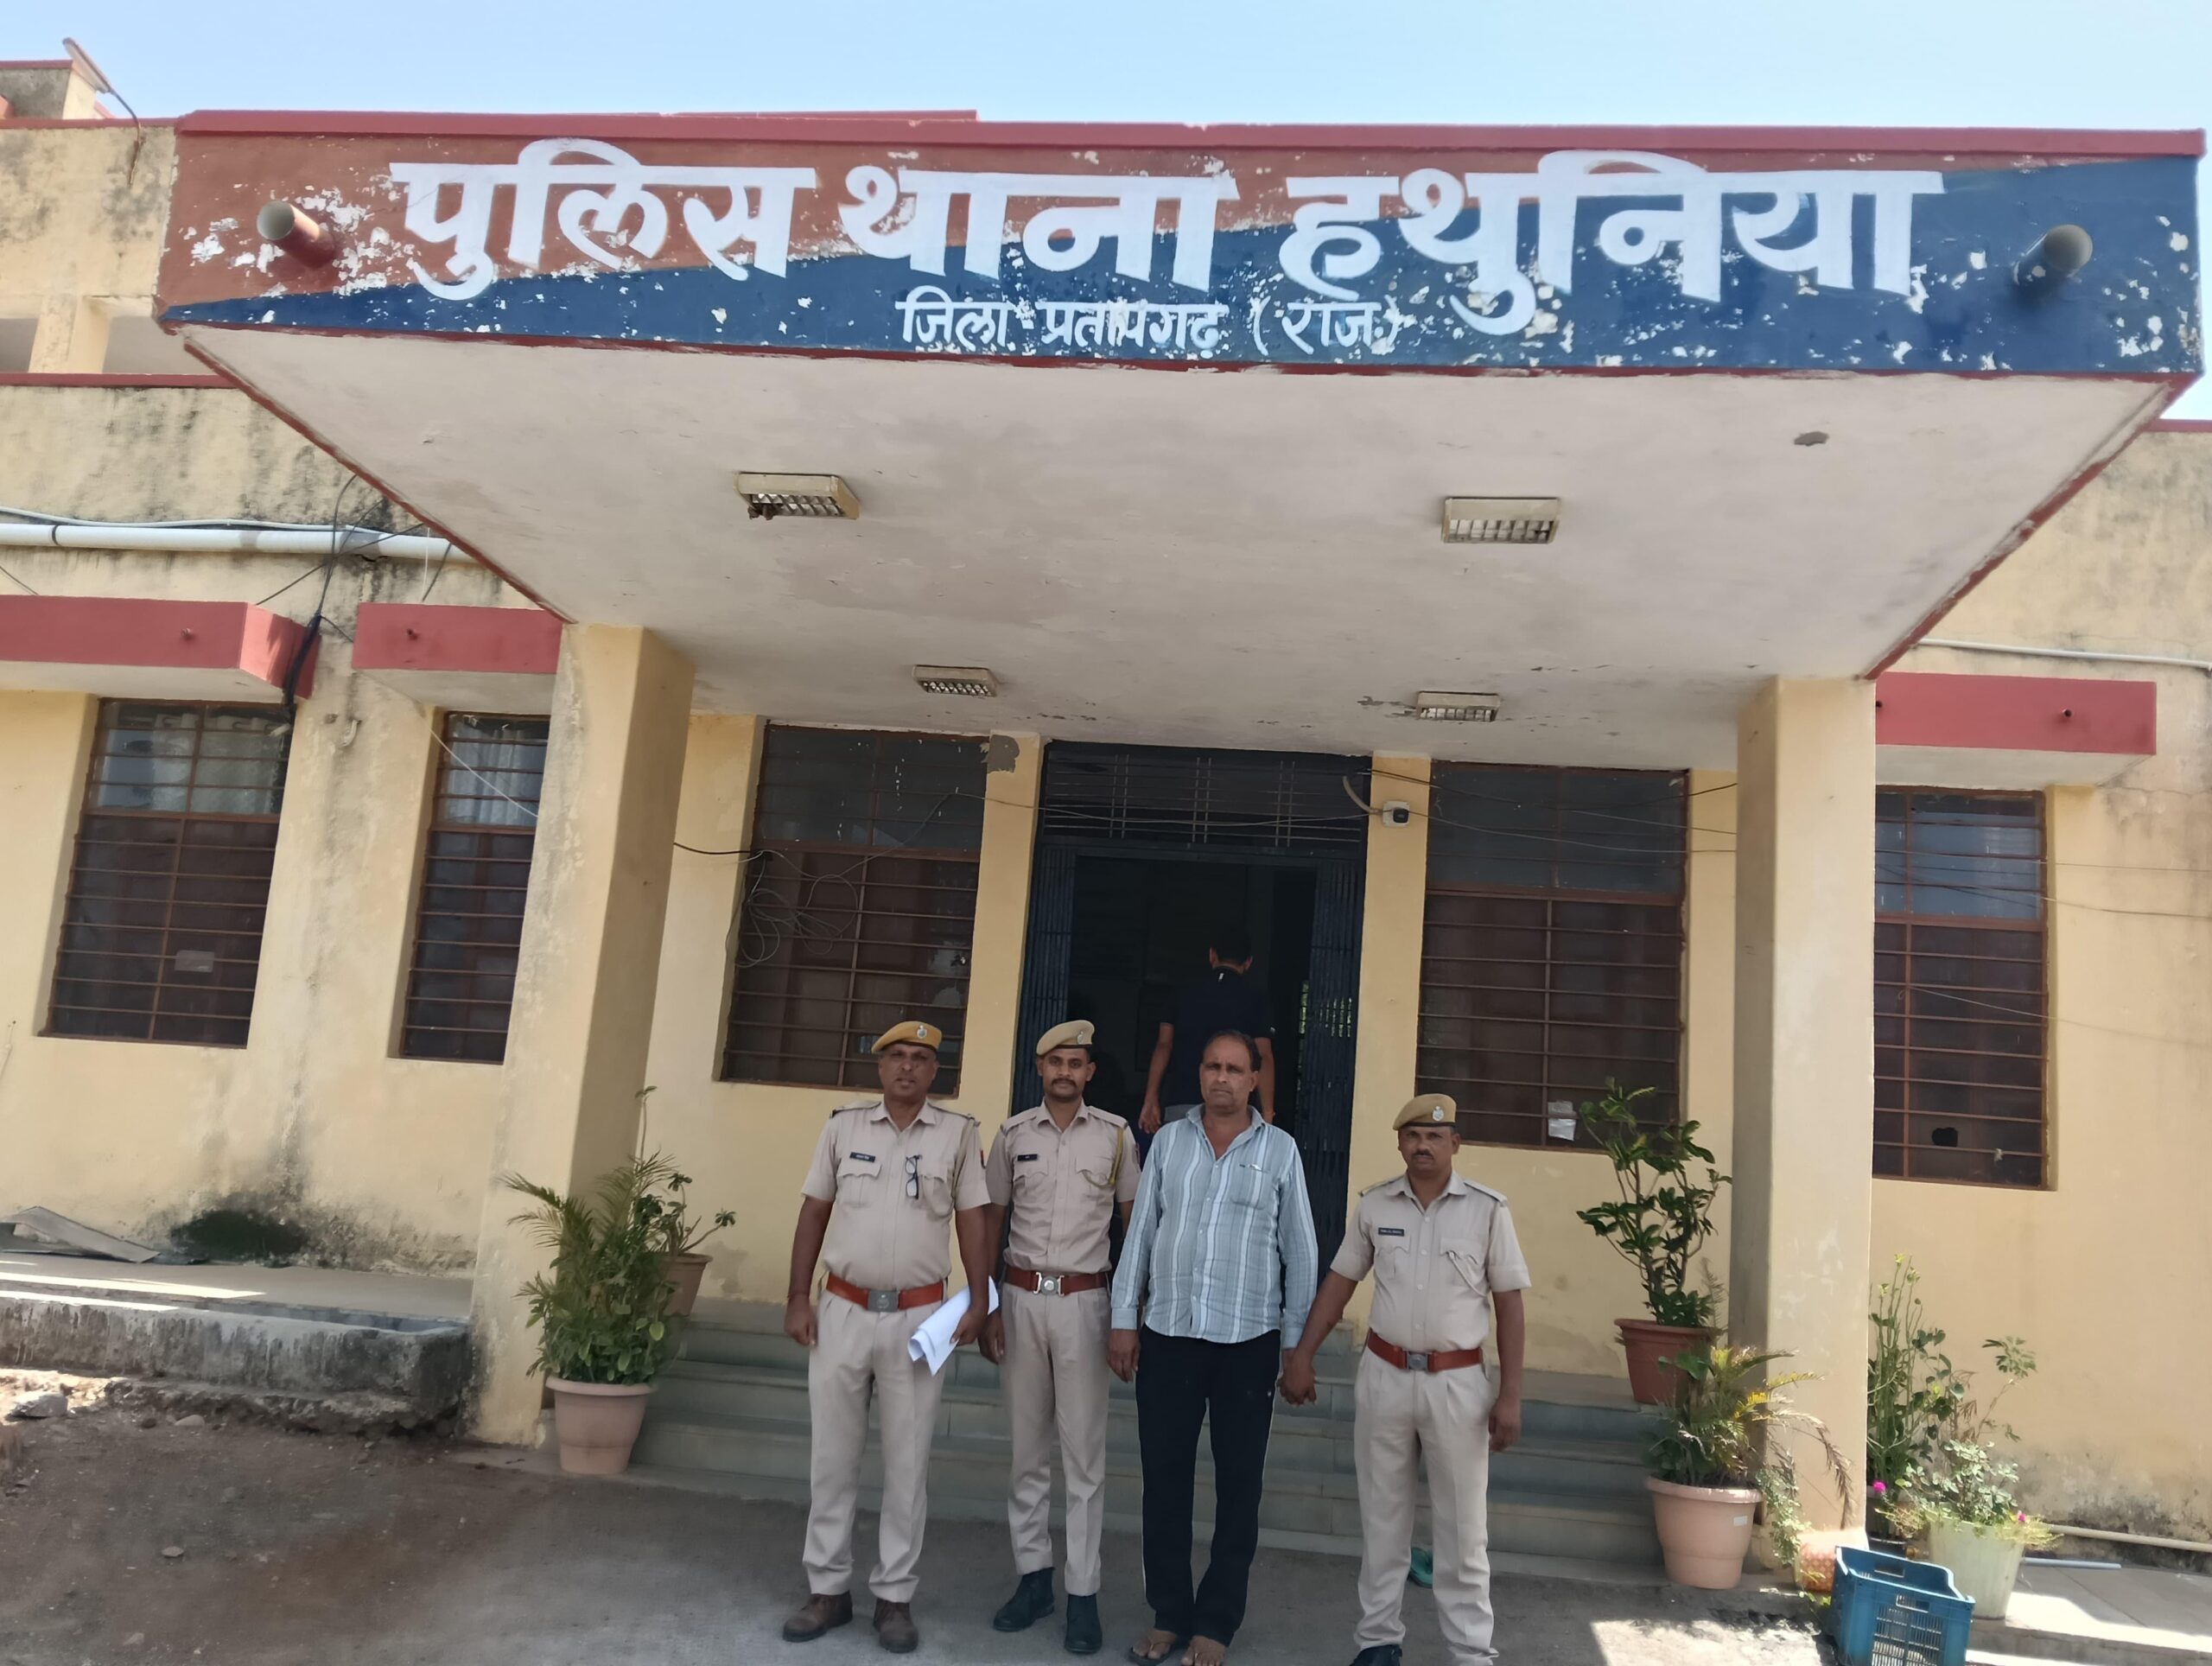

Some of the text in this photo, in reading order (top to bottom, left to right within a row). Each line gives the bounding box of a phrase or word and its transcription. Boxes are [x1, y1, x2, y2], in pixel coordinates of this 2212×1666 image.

[389, 137, 1944, 335] पुलिस थाना हथुनिया
